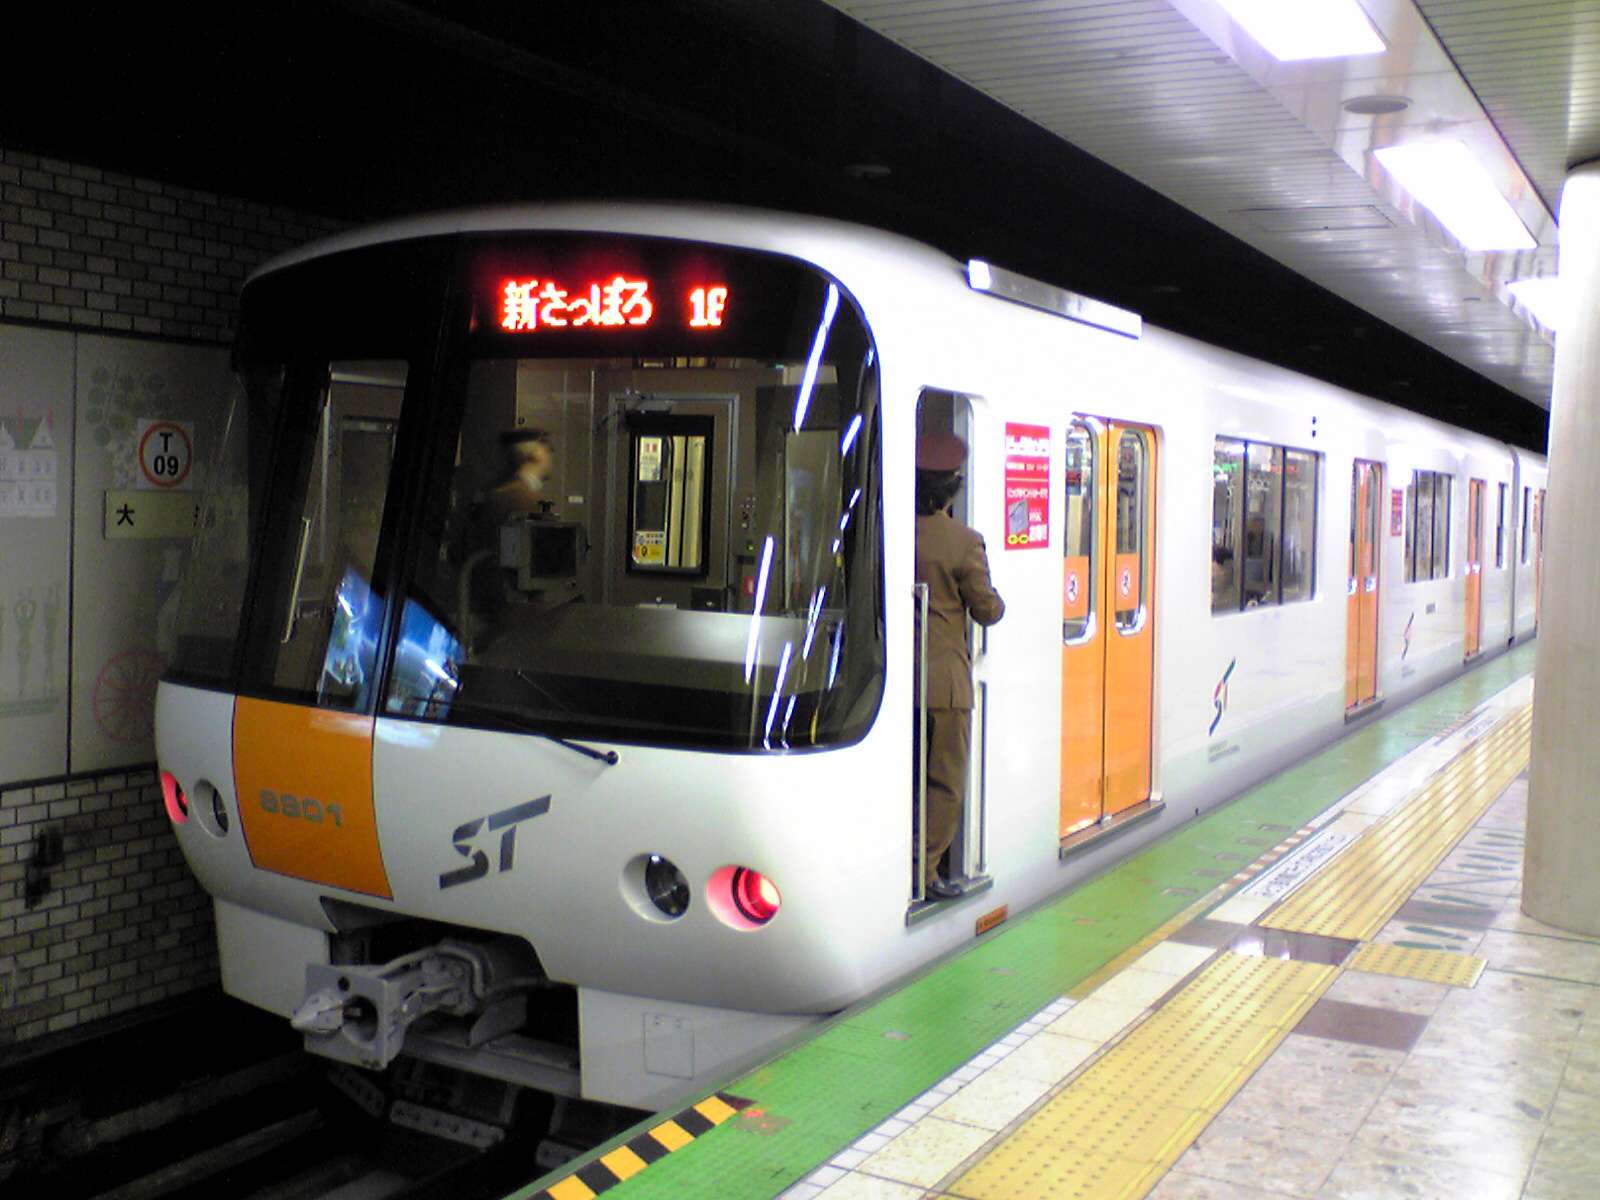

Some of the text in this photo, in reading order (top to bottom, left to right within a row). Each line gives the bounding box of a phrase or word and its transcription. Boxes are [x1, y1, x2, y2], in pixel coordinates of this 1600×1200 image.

[501, 276, 653, 330] 新さっぽろ
[159, 432, 174, 454] T
[153, 455, 180, 477] 09
[439, 793, 552, 890] ST
